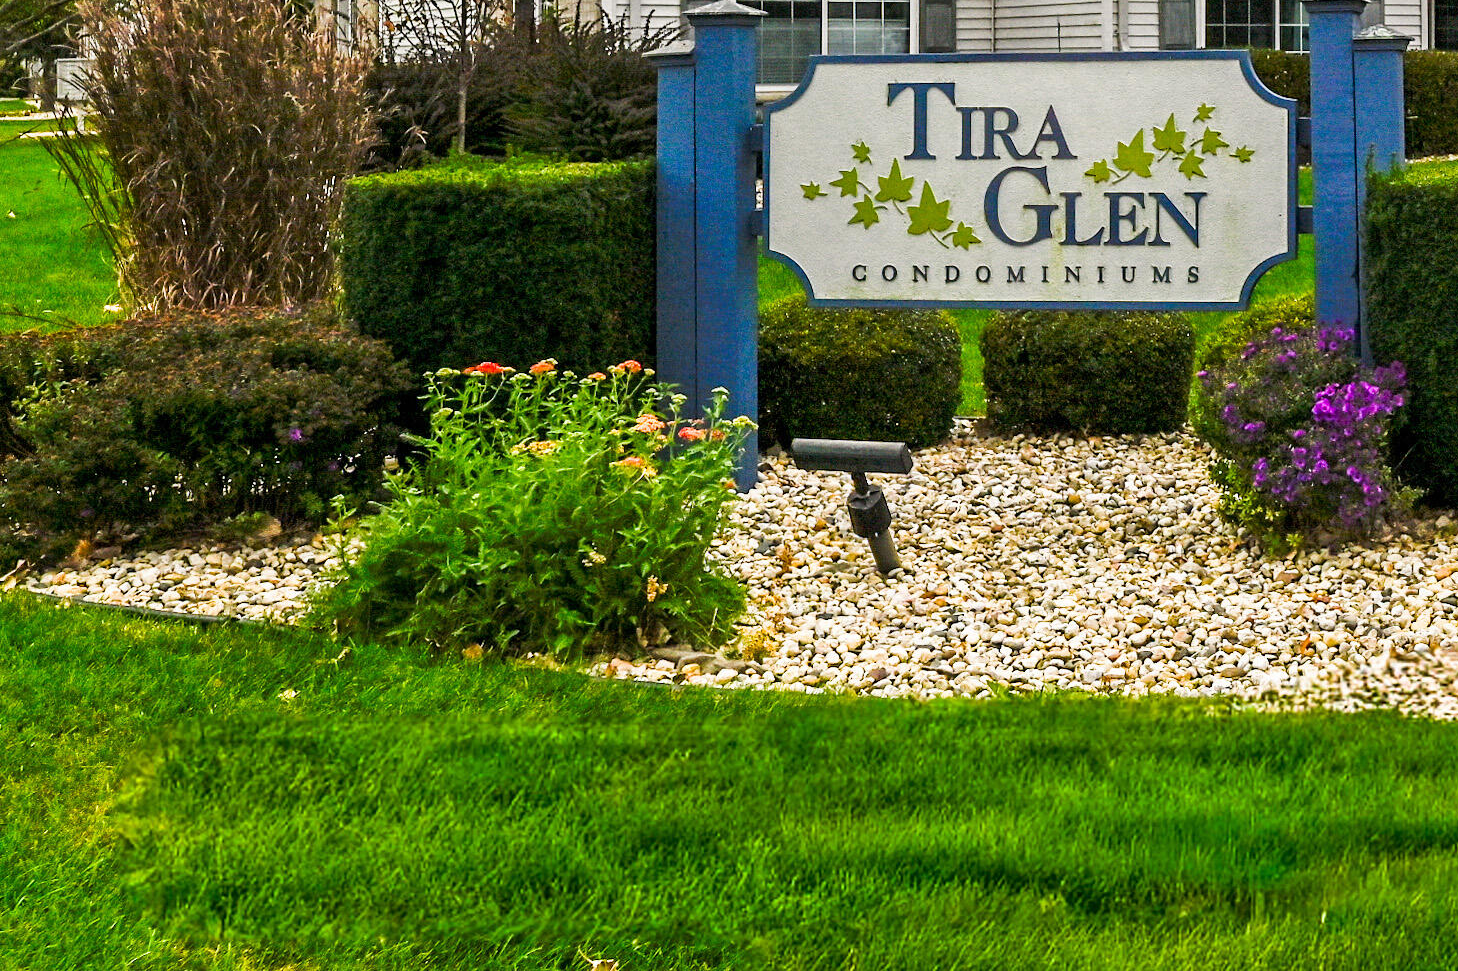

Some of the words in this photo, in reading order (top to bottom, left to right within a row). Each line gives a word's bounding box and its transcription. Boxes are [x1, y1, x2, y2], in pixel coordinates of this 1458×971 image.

[887, 82, 1078, 161] TIRA
[983, 165, 1207, 249] GLEN
[851, 264, 1200, 284] CONDOMINIUMS
